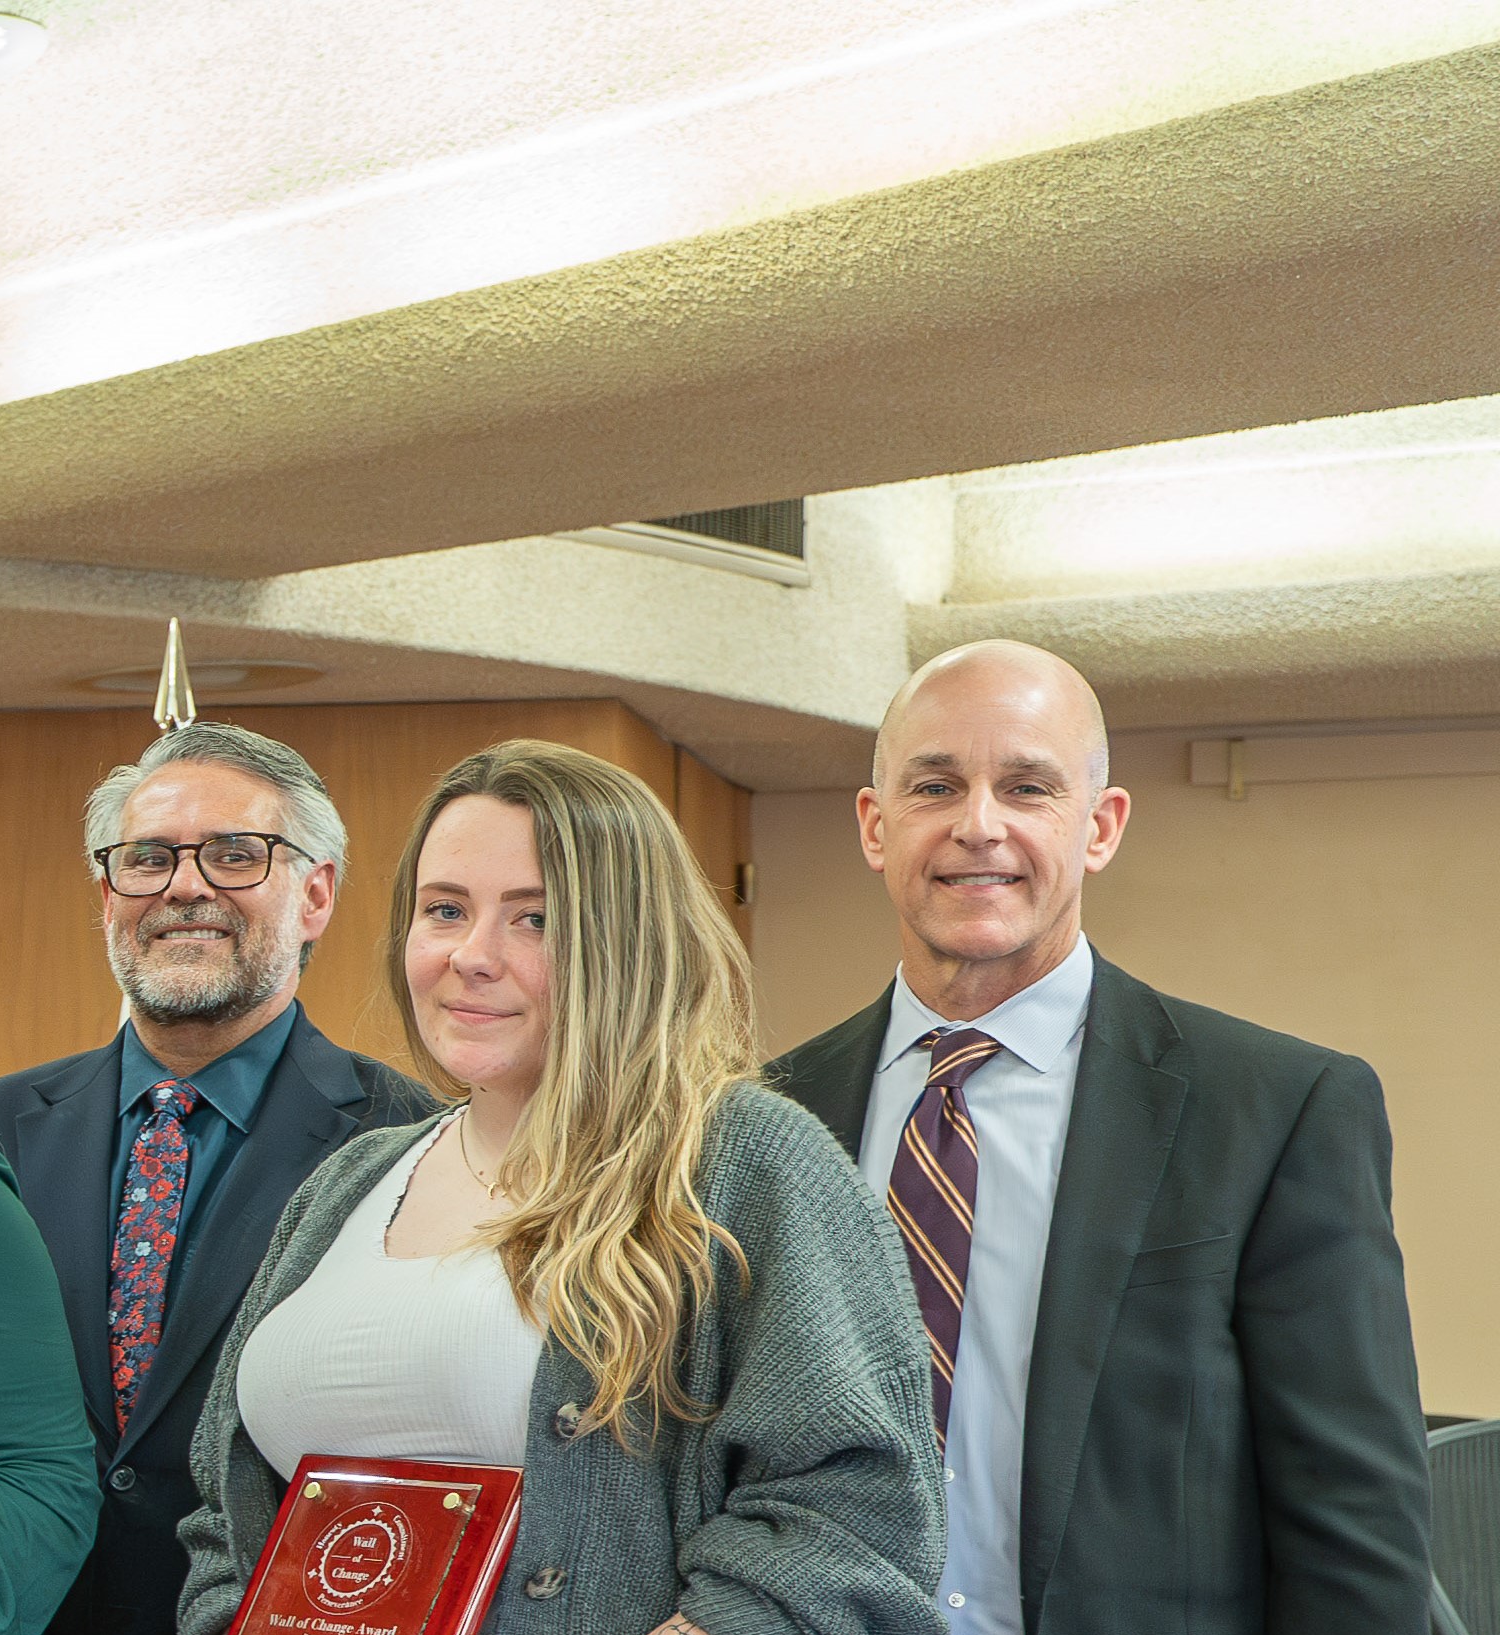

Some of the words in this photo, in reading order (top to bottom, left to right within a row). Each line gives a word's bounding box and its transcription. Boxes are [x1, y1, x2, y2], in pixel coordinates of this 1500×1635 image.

[316, 1522, 343, 1549] Honesty
[353, 1536, 377, 1548] Wall
[352, 1554, 363, 1563] of
[332, 1568, 369, 1583] Change
[317, 1593, 364, 1608] Perseverance
[270, 1614, 296, 1628] Wall
[297, 1618, 311, 1629] of
[311, 1618, 354, 1635] Change
